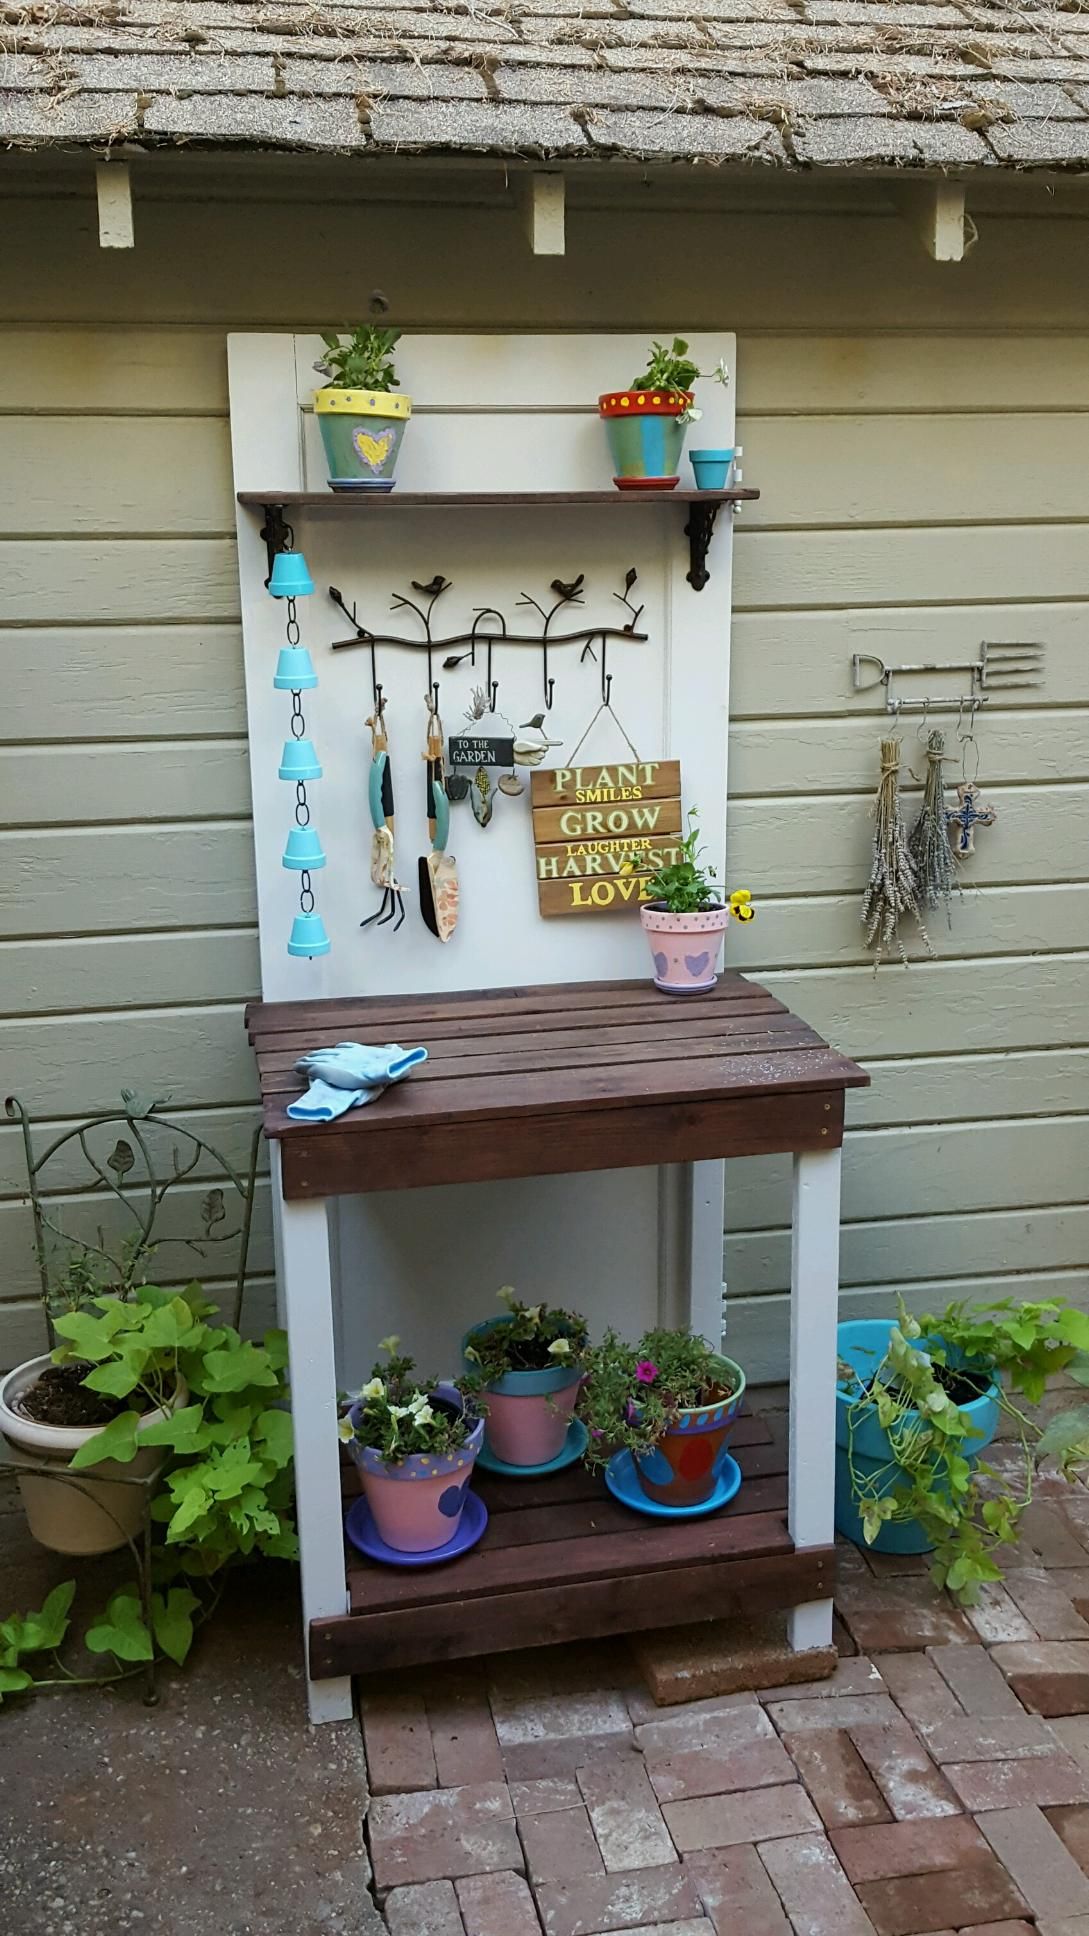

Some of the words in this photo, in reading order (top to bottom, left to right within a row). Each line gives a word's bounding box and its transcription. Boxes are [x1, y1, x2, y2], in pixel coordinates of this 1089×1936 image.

[457, 740, 469, 749] TO
[472, 740, 489, 749] THE
[453, 751, 496, 762] GARDEN
[554, 763, 659, 793] PLANT
[575, 786, 642, 804] SMILES
[560, 806, 662, 836] GROW
[566, 838, 653, 856] LAUGHTER
